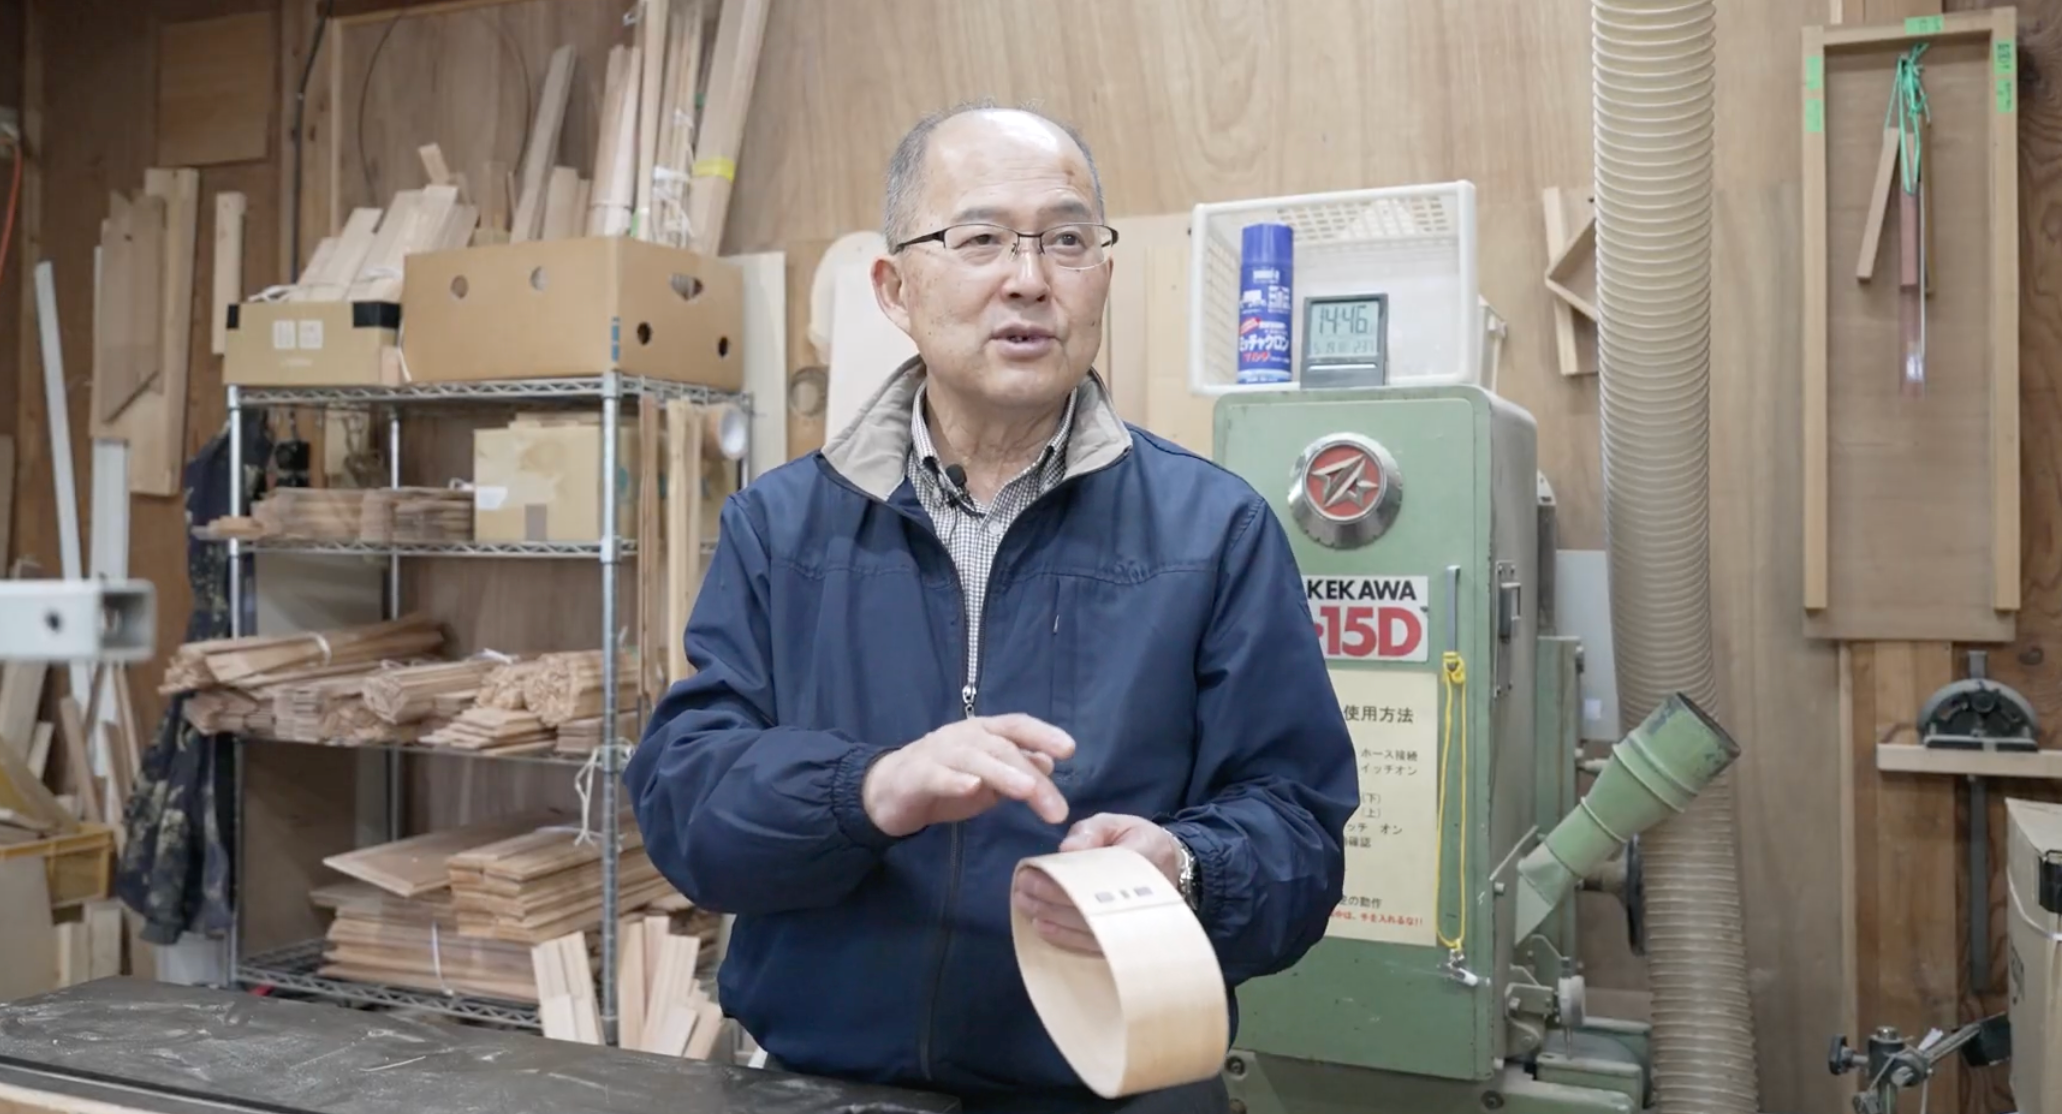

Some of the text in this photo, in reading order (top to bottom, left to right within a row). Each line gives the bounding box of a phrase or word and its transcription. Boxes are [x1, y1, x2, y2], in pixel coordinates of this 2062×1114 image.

[1344, 705, 1415, 724] 使用方法
[1361, 748, 1418, 762] ホース接続
[1344, 836, 1372, 848] 確認
